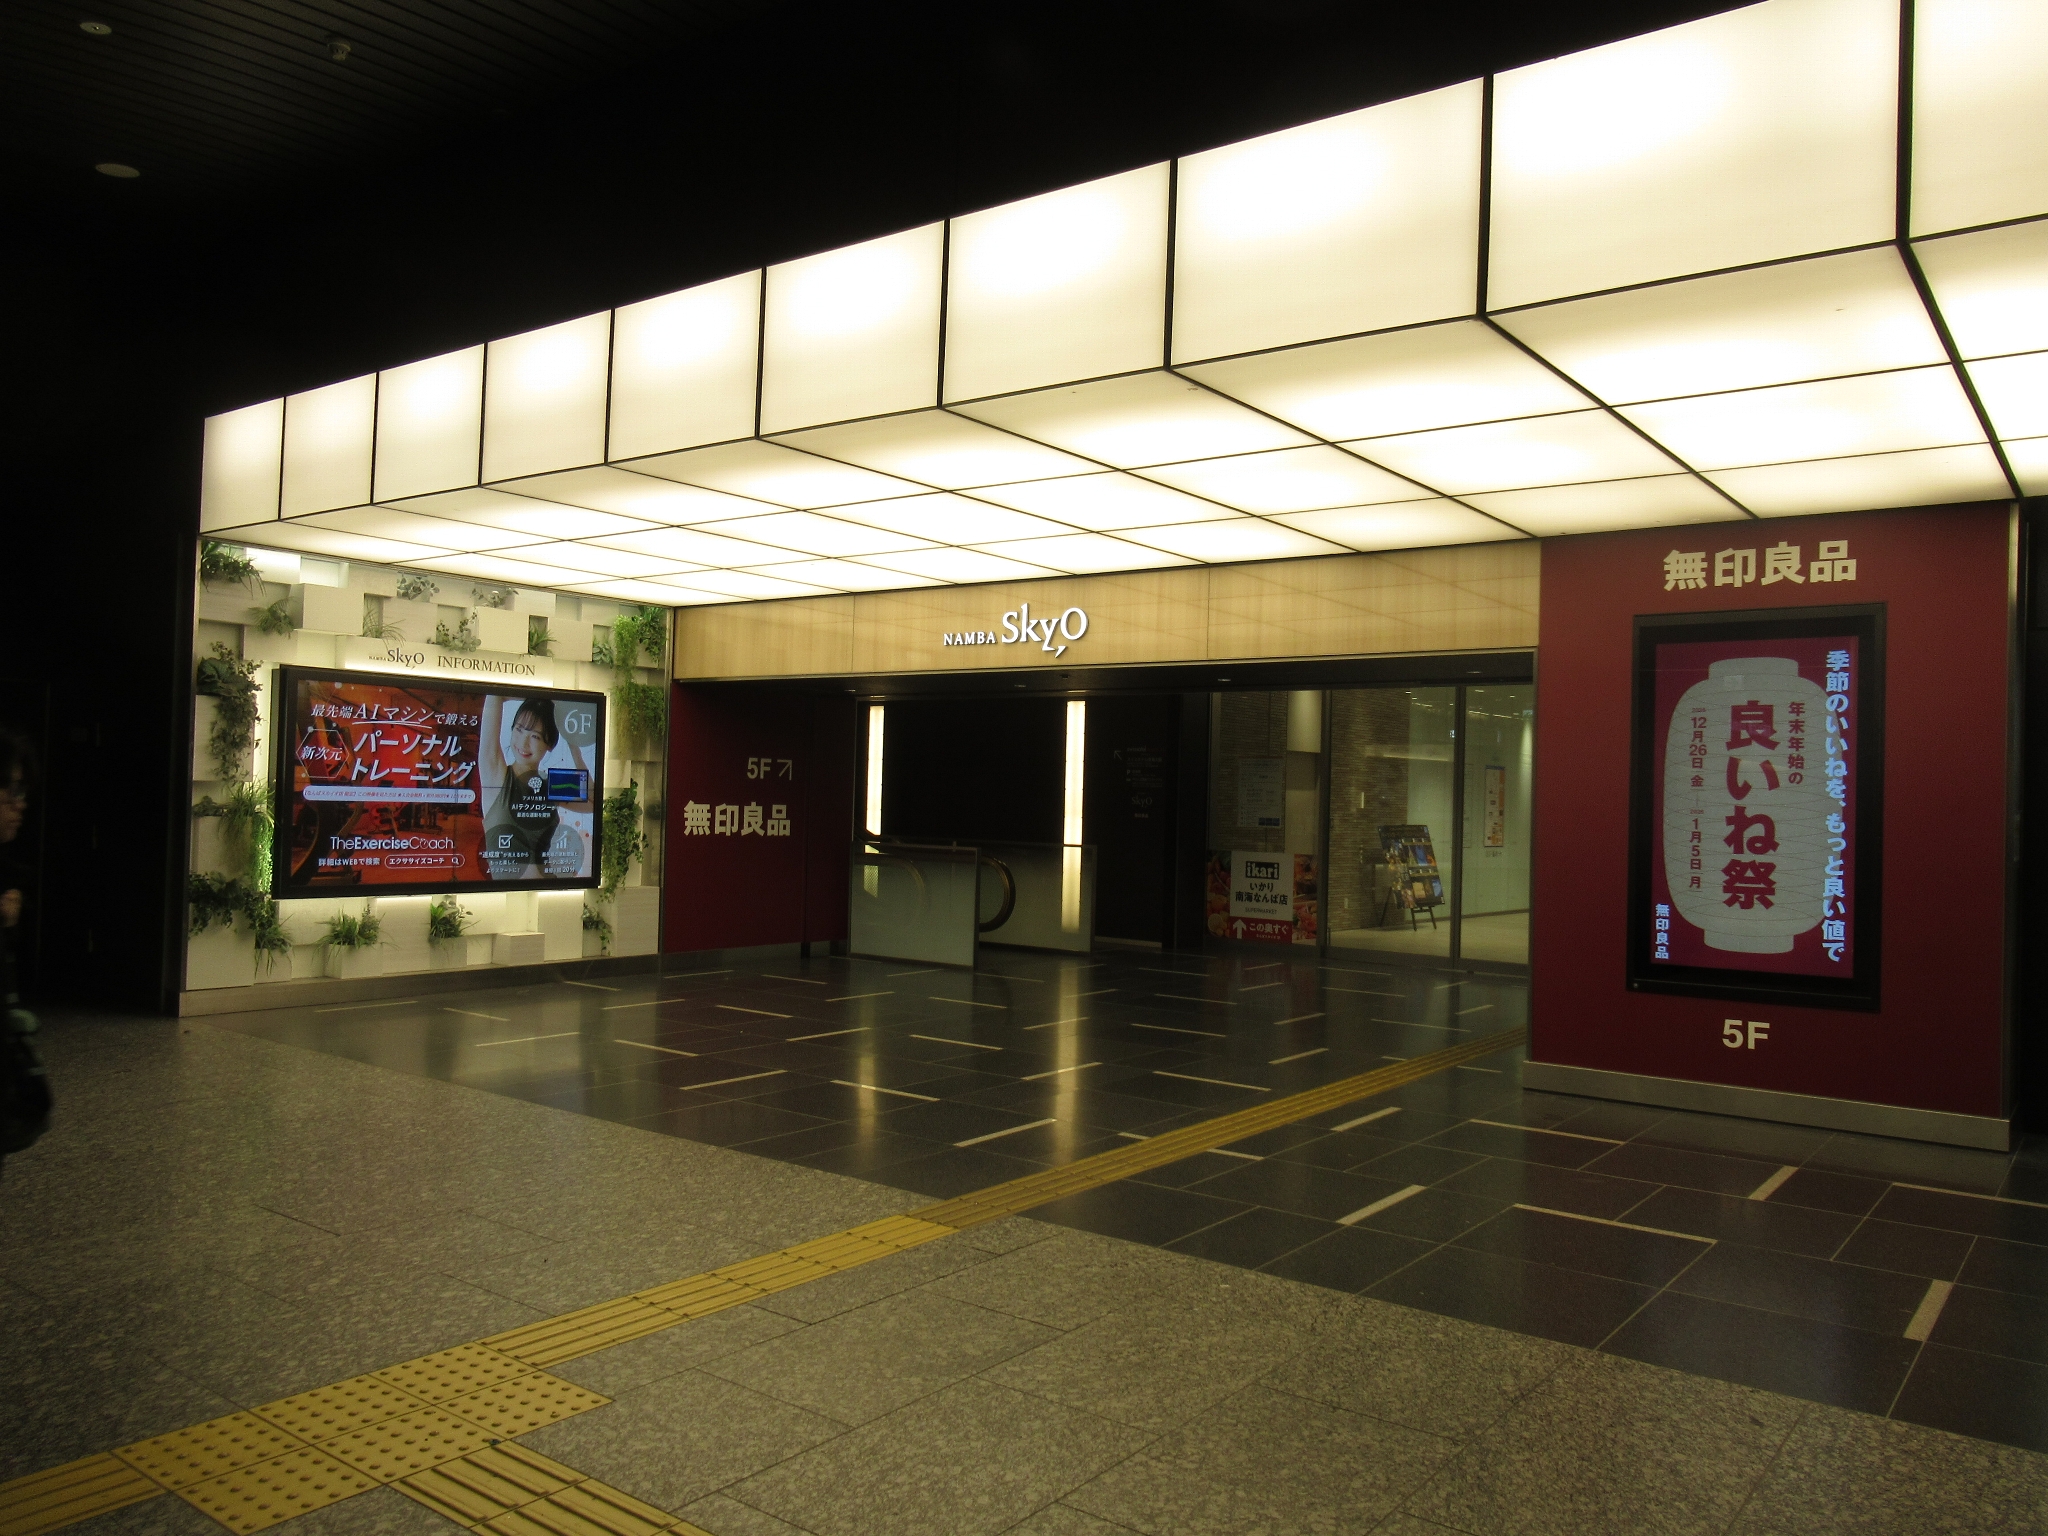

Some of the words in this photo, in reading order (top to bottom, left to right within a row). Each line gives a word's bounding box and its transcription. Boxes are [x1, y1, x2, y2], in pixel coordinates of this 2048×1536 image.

[1663, 540, 1857, 592] 無印良品
[943, 631, 996, 646] NAMBA
[1001, 602, 1089, 658] SkyO
[387, 648, 425, 670] SkyO
[437, 655, 536, 676] INFORMATION
[310, 702, 479, 727] 最先端AIマシンで鍛える
[564, 709, 592, 735] 6F
[301, 745, 343, 761] 新次元
[353, 729, 462, 757] パーソナル
[1787, 702, 1806, 785] 年末年始の
[351, 757, 476, 785] トレーニング
[746, 757, 772, 779] 5F
[683, 800, 792, 836] 無印良品
[1720, 700, 1781, 911] 良いね祭
[1821, 650, 1850, 962] 季節のいいねを、もっと良い値で
[389, 857, 445, 865] エクササイズコーチ
[1246, 862, 1279, 879] ikari
[1235, 891, 1288, 905] 南海なんば店
[1249, 882, 1274, 892] いかり
[1249, 923, 1288, 935] この奥すぐ
[1655, 903, 1669, 959] 無印良品
[1722, 1018, 1770, 1050] 5F
